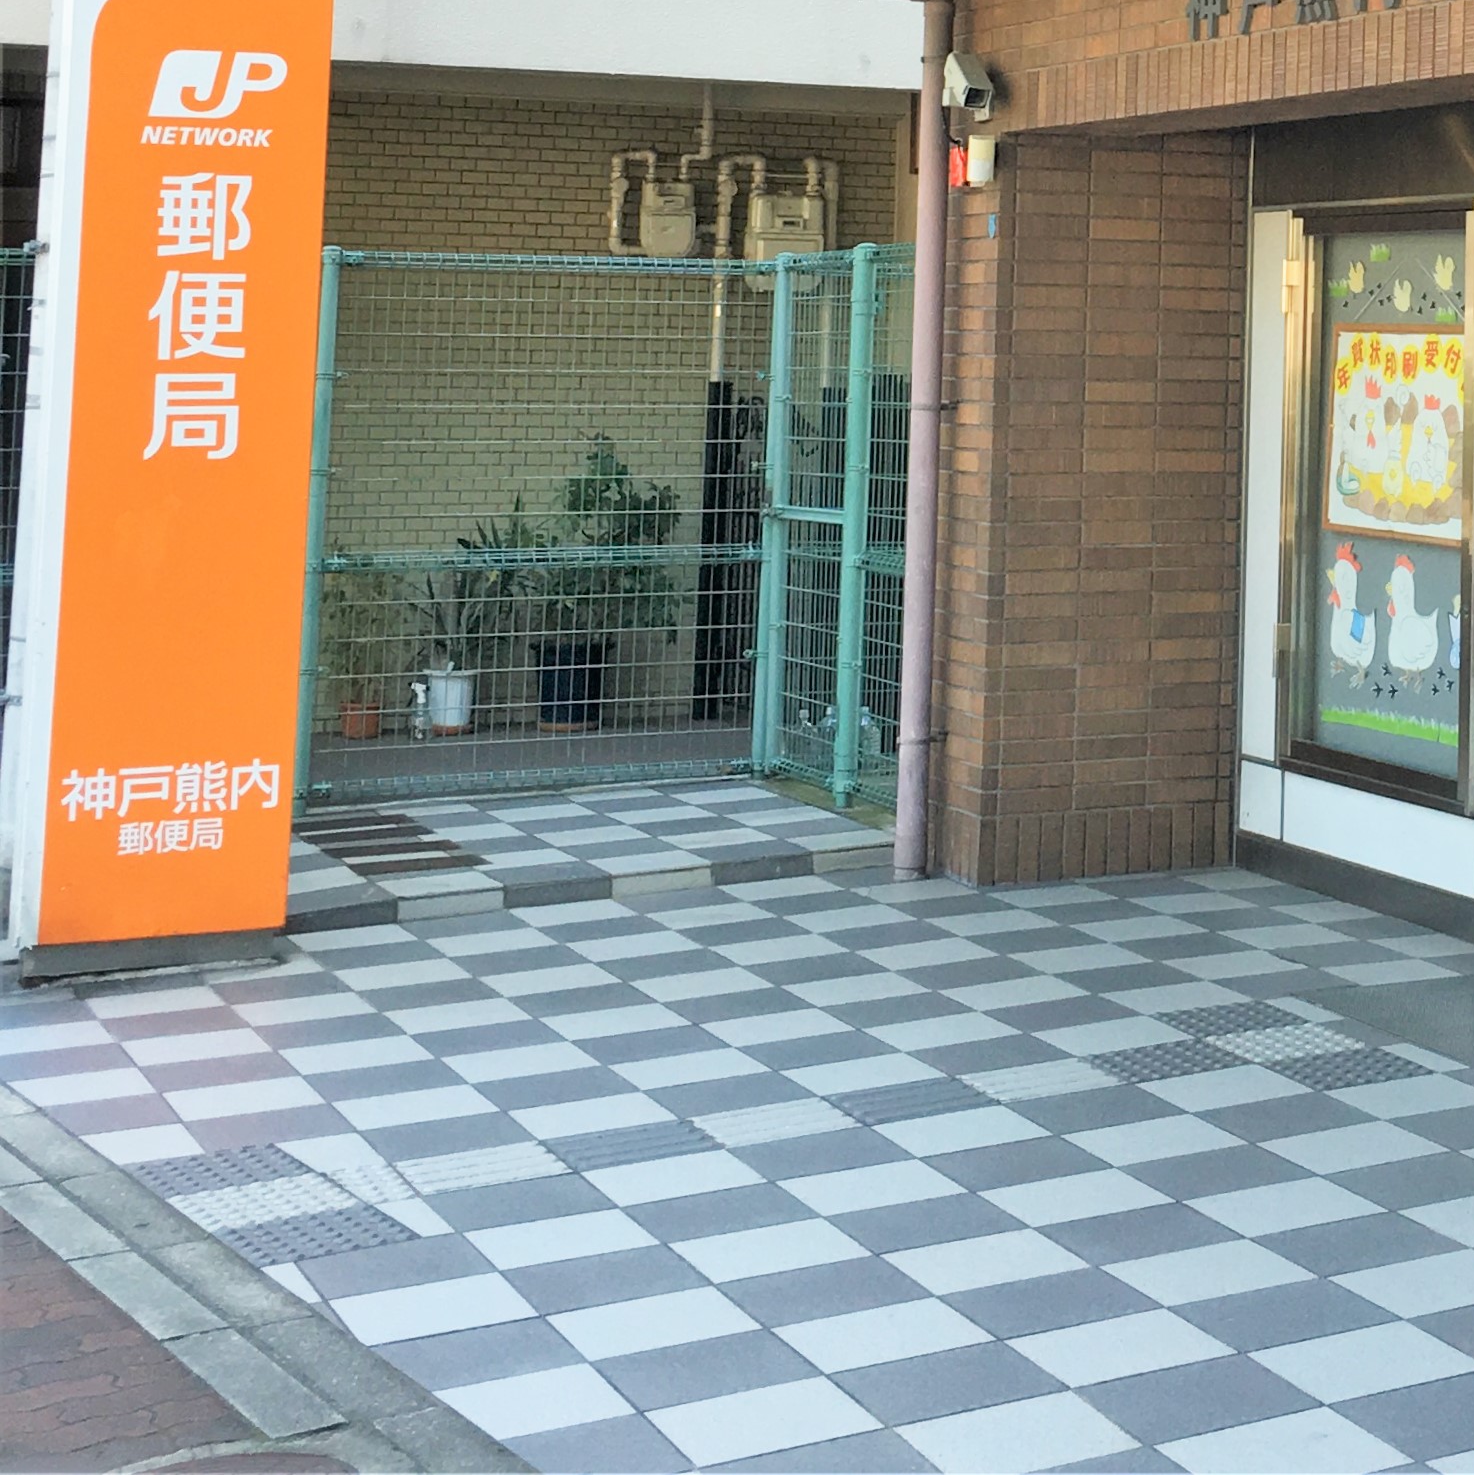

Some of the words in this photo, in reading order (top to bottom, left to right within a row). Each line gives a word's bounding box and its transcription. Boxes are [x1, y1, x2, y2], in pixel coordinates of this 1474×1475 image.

[148, 49, 288, 119] JP
[140, 125, 272, 148] NETWORK
[143, 172, 253, 461] 郵便局
[1336, 336, 1465, 391] 年賀状印刷受付
[60, 758, 281, 822] 神戸熊内
[117, 817, 225, 857] 郵便局
